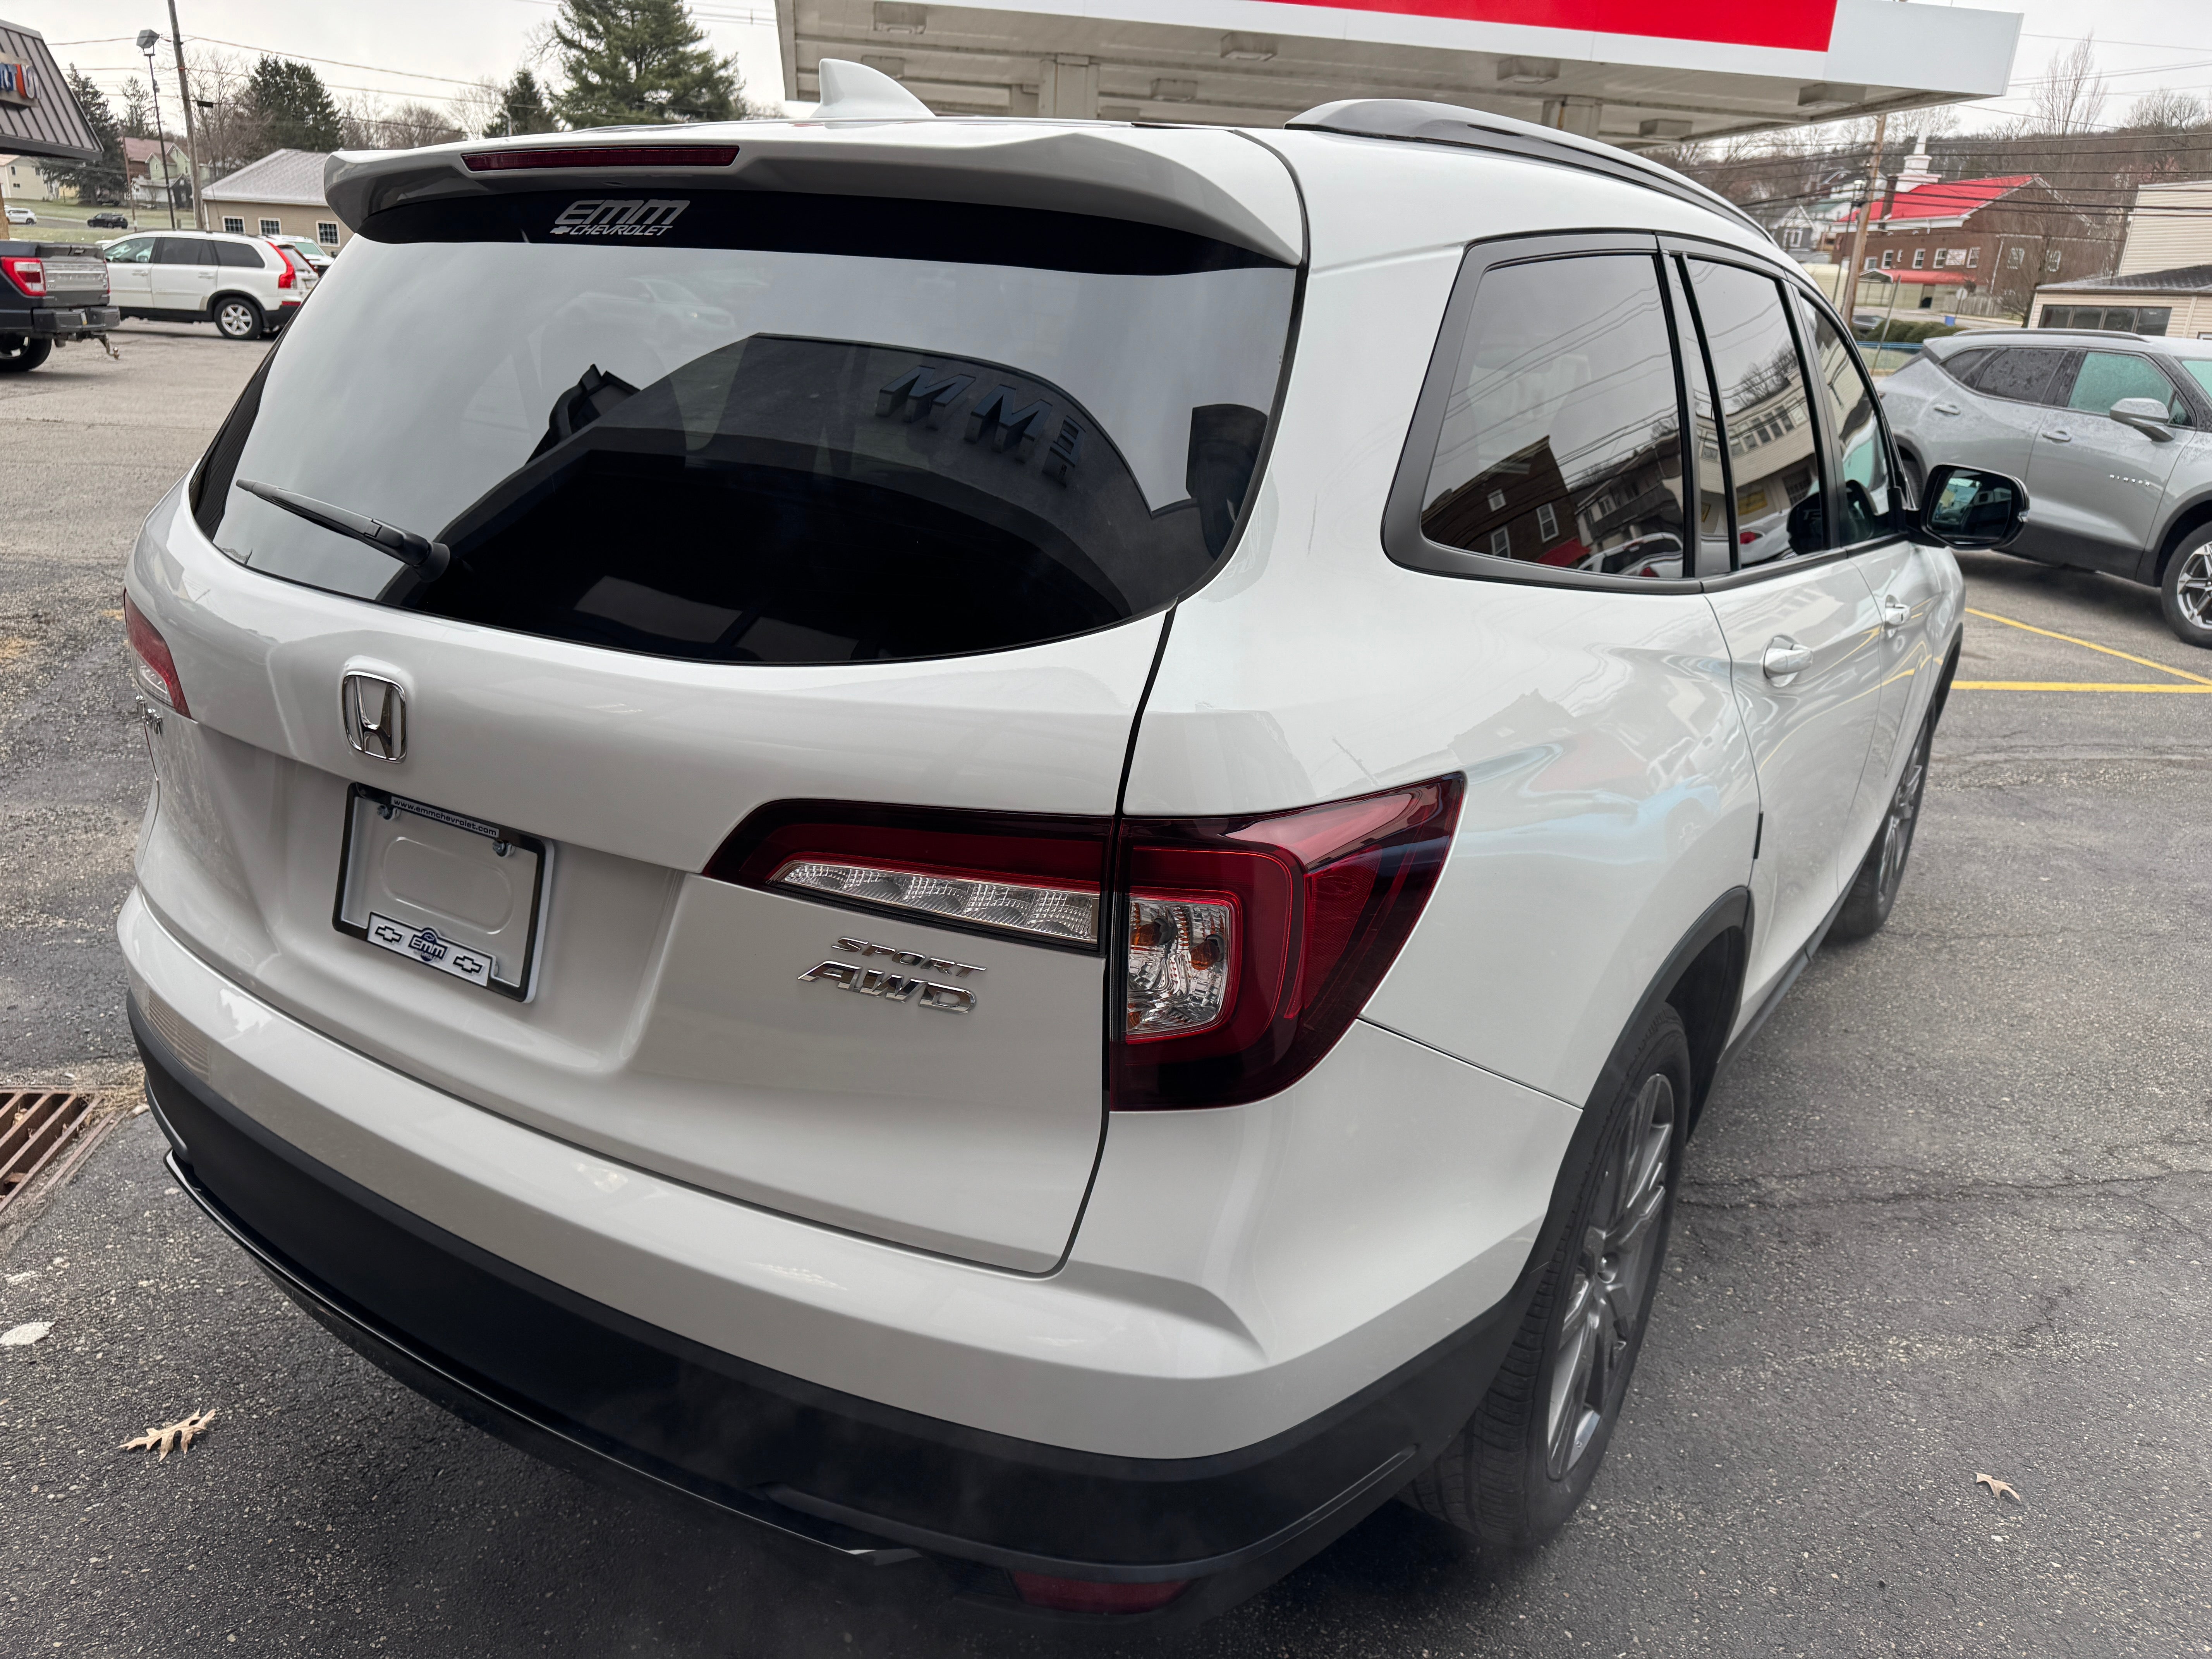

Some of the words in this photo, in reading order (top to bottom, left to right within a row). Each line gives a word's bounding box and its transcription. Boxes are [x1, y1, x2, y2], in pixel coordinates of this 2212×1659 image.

[555, 199, 690, 225] EMM
[569, 225, 673, 236] CHEVROLET
[394, 799, 497, 836] www.emmchevrolet.com
[411, 937, 445, 957] EMM
[831, 936, 987, 978] SPORT
[797, 961, 977, 1015] AWD
